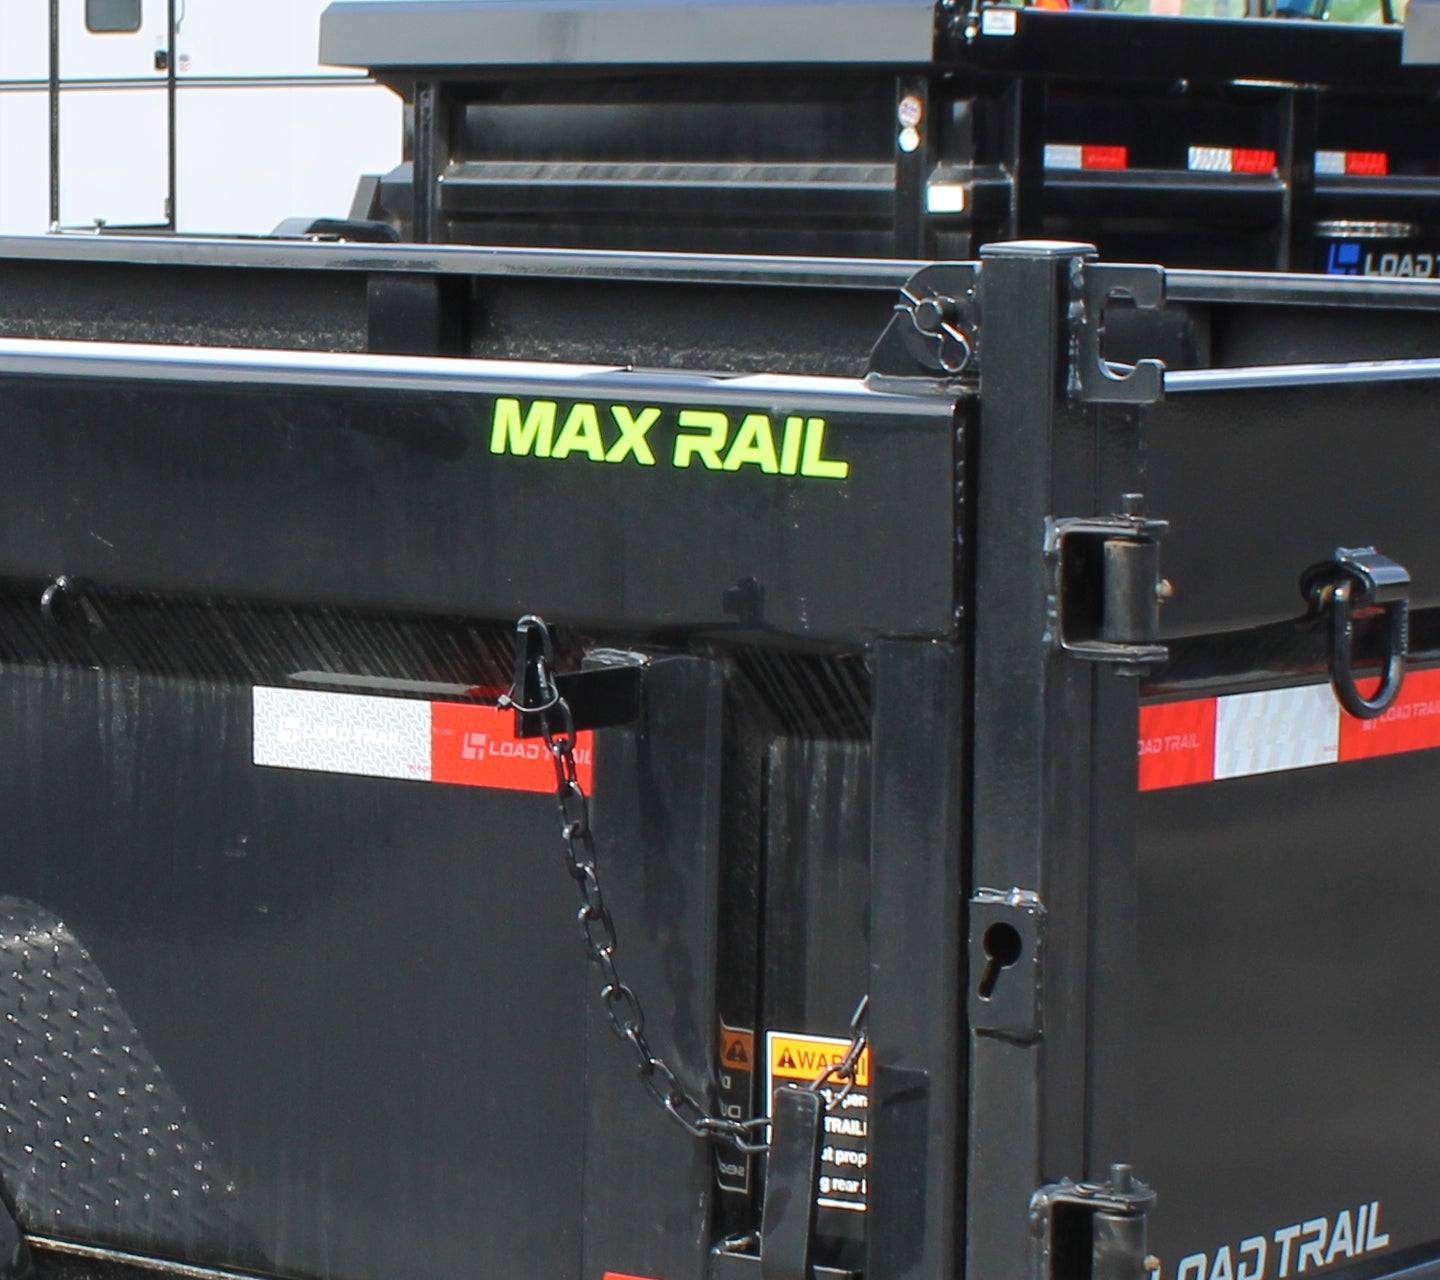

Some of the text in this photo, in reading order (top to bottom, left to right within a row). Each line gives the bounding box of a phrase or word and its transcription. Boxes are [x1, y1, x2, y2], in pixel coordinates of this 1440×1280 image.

[1364, 252, 1433, 278] LOAD
[489, 396, 850, 479] MAX RAIL
[489, 743, 592, 765] LOAD TAIL
[1138, 733, 1201, 756] OAD TRAIL
[824, 1116, 868, 1137] TRAIL
[832, 1178, 861, 1193] rear
[1273, 1200, 1391, 1279] TRAIL
